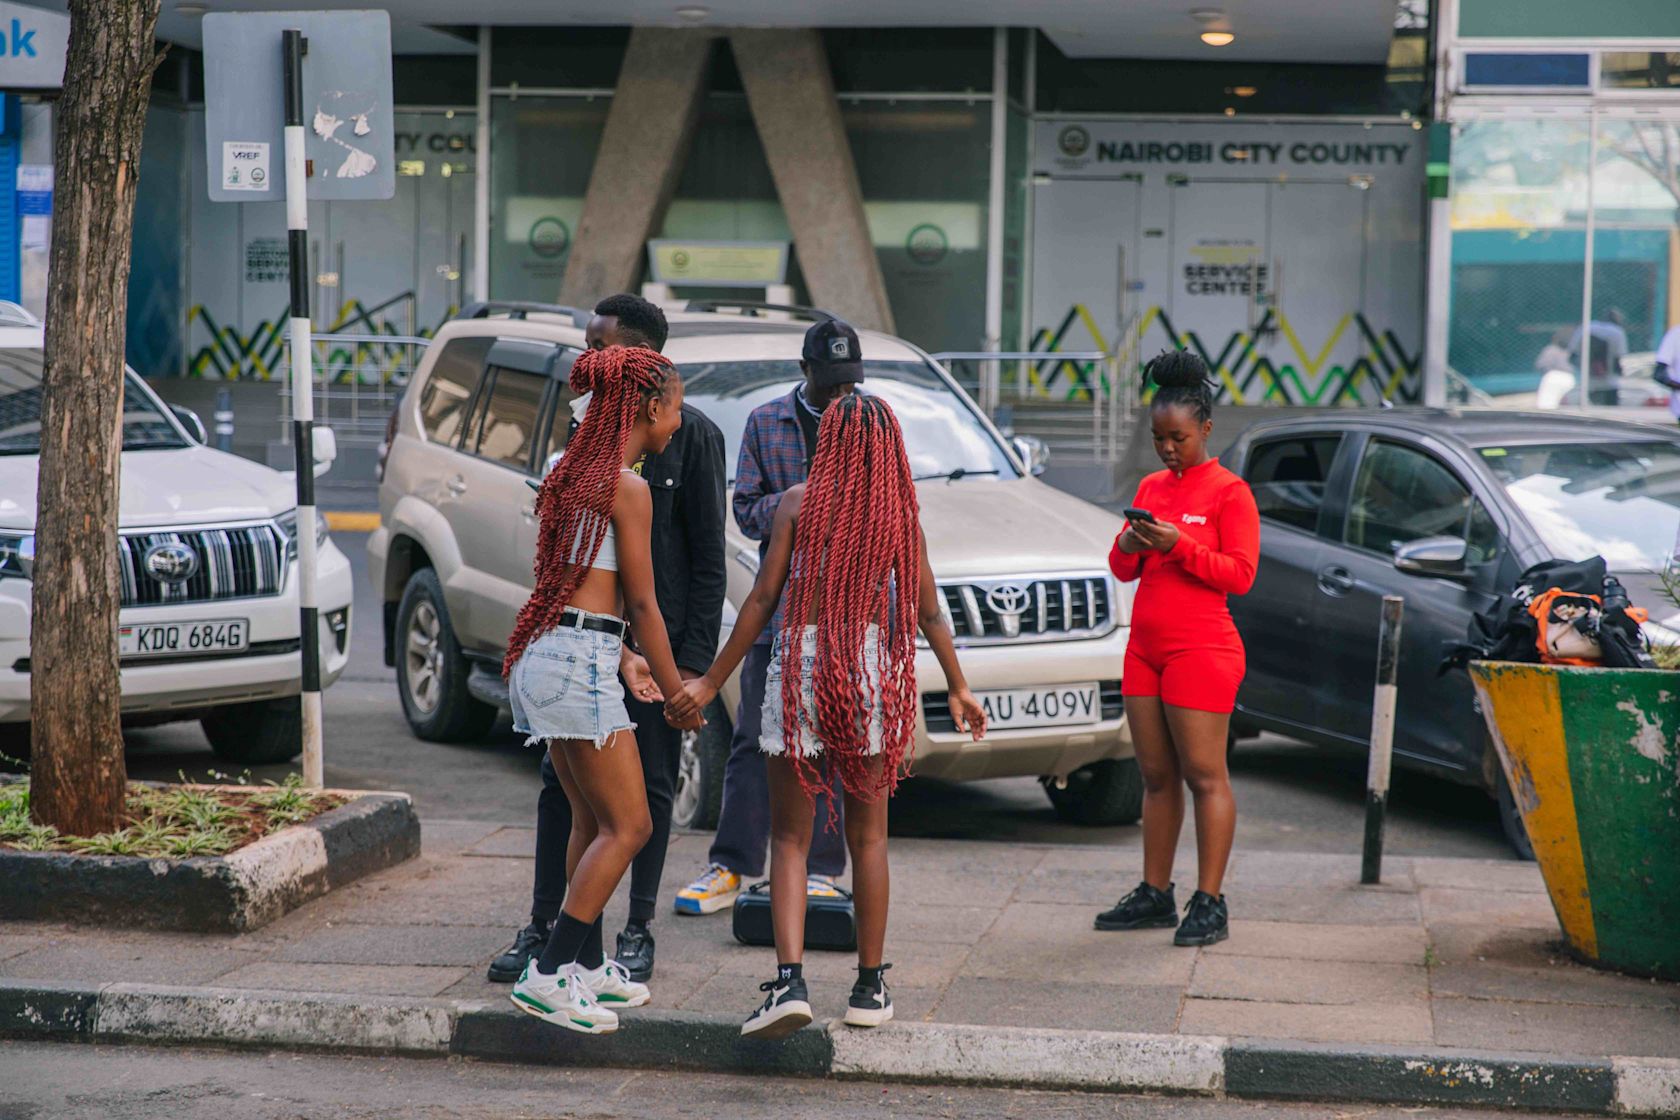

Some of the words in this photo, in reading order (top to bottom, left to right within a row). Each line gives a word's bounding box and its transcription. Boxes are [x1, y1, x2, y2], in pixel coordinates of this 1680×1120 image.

[0, 17, 37, 58] k
[1097, 142, 1213, 164] NAIROBI
[1220, 143, 1283, 164] CITY
[1290, 143, 1411, 164] COUNTY
[137, 627, 180, 651] KDQ
[188, 624, 241, 649] 684G
[980, 695, 1014, 723] AU
[1024, 689, 1095, 718] 409V
